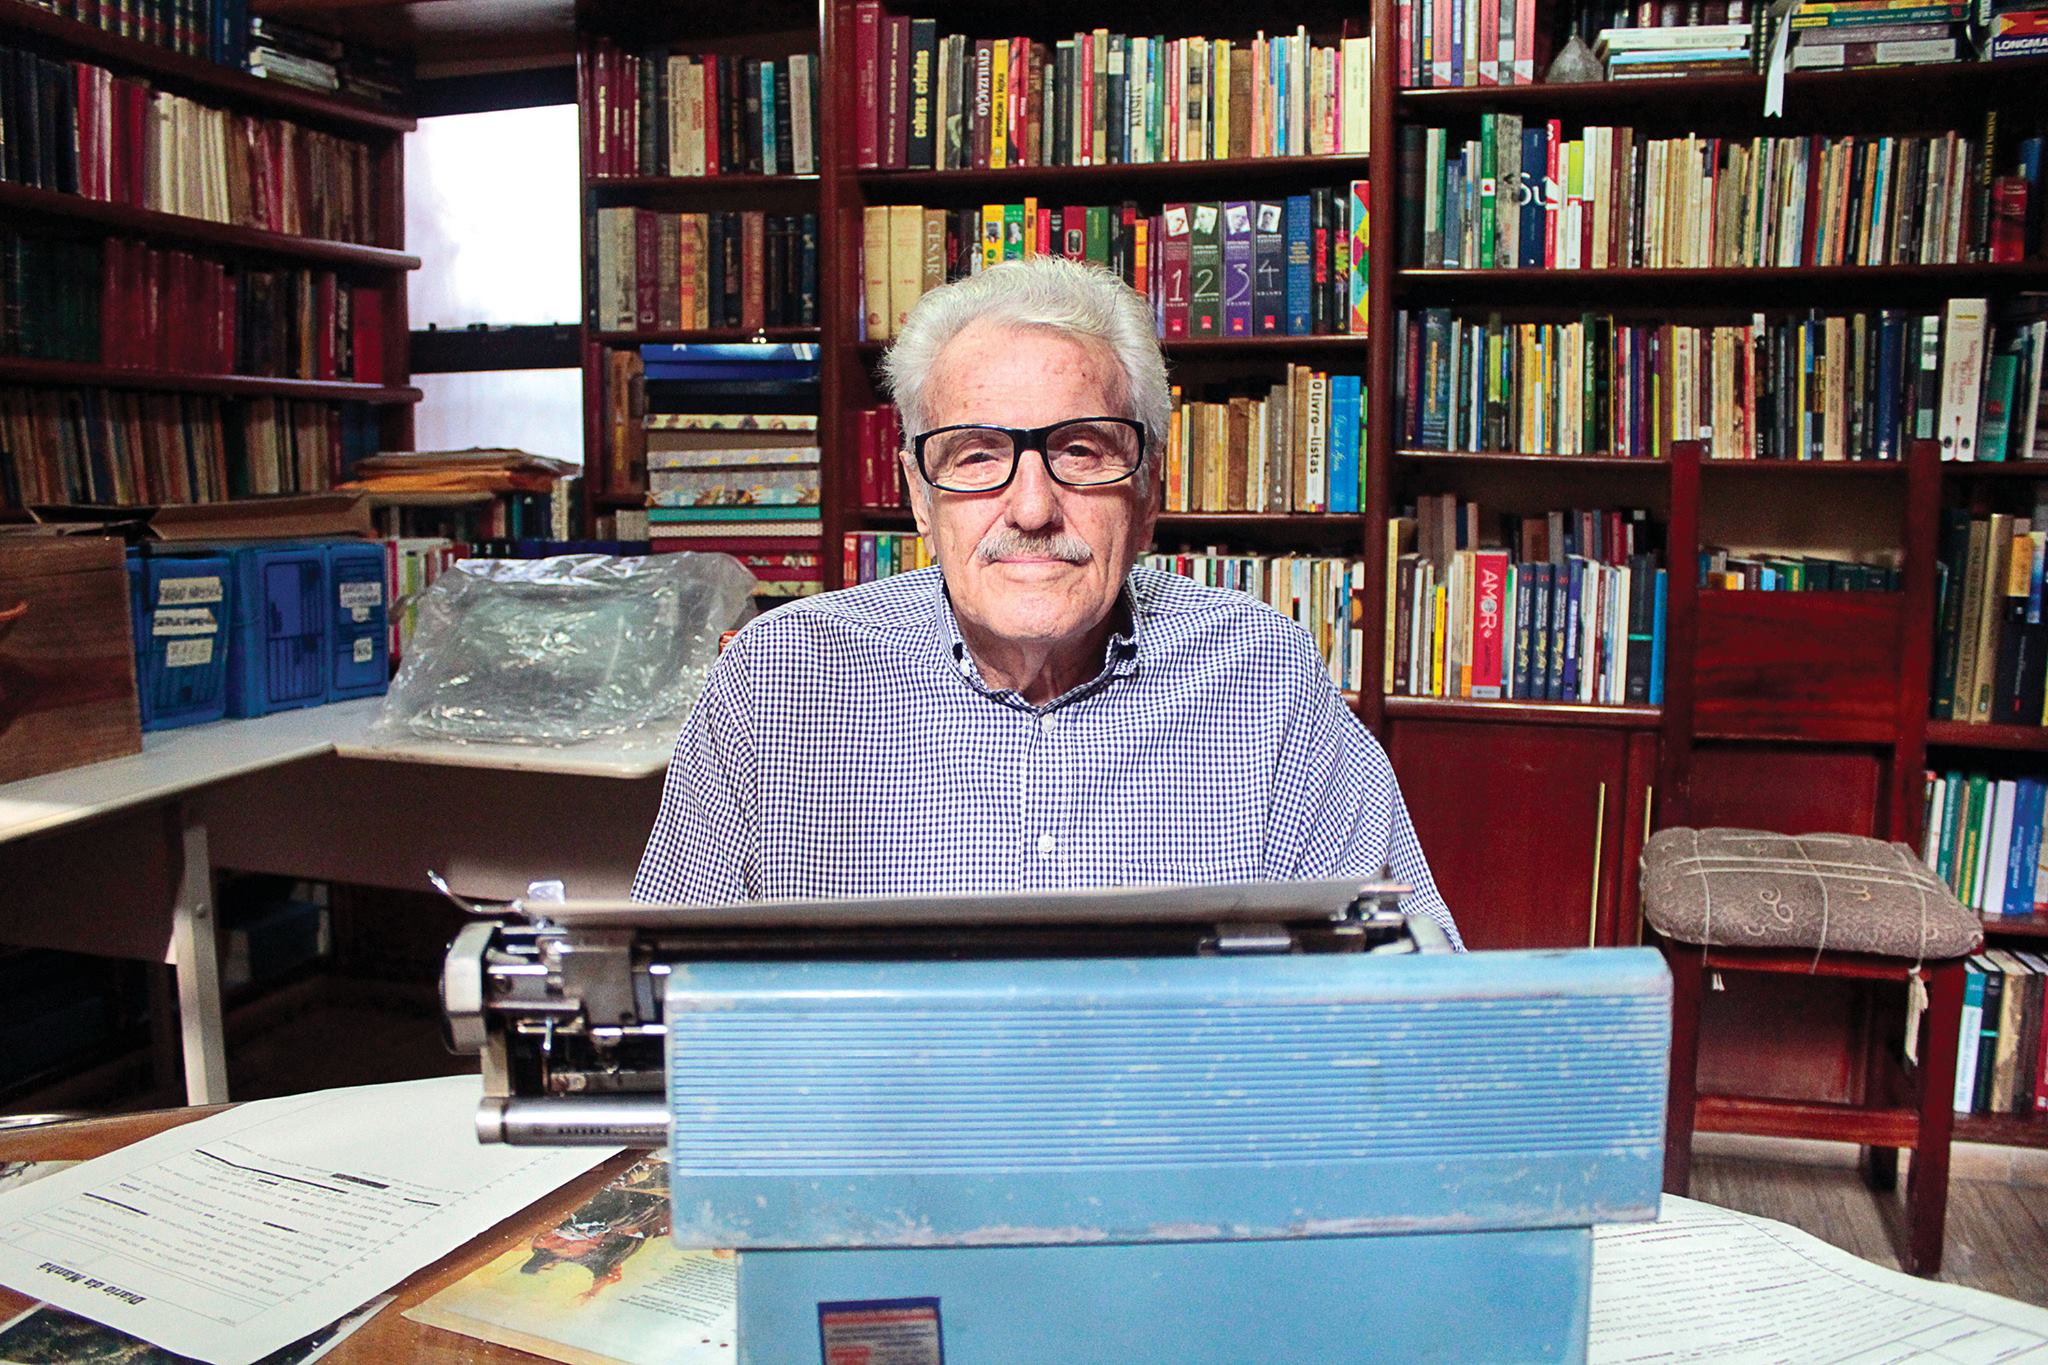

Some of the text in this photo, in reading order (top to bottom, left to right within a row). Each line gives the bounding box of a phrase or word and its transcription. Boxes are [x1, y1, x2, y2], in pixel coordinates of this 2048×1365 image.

[1994, 37, 2048, 50] LONGMA
[913, 50, 929, 138] cobras criadas
[976, 48, 990, 117] CIVILIZAÇÃO
[1168, 269, 1184, 302] 1
[1194, 268, 1219, 298] 2
[1226, 263, 1250, 302] 3
[1258, 259, 1280, 288] 4
[1312, 381, 1323, 389] O
[1311, 392, 1322, 424] livro
[1310, 436, 1322, 475] listas
[1480, 568, 1499, 631] AMOR
[84, 1278, 106, 1289] da
[103, 1285, 147, 1306] Diário
